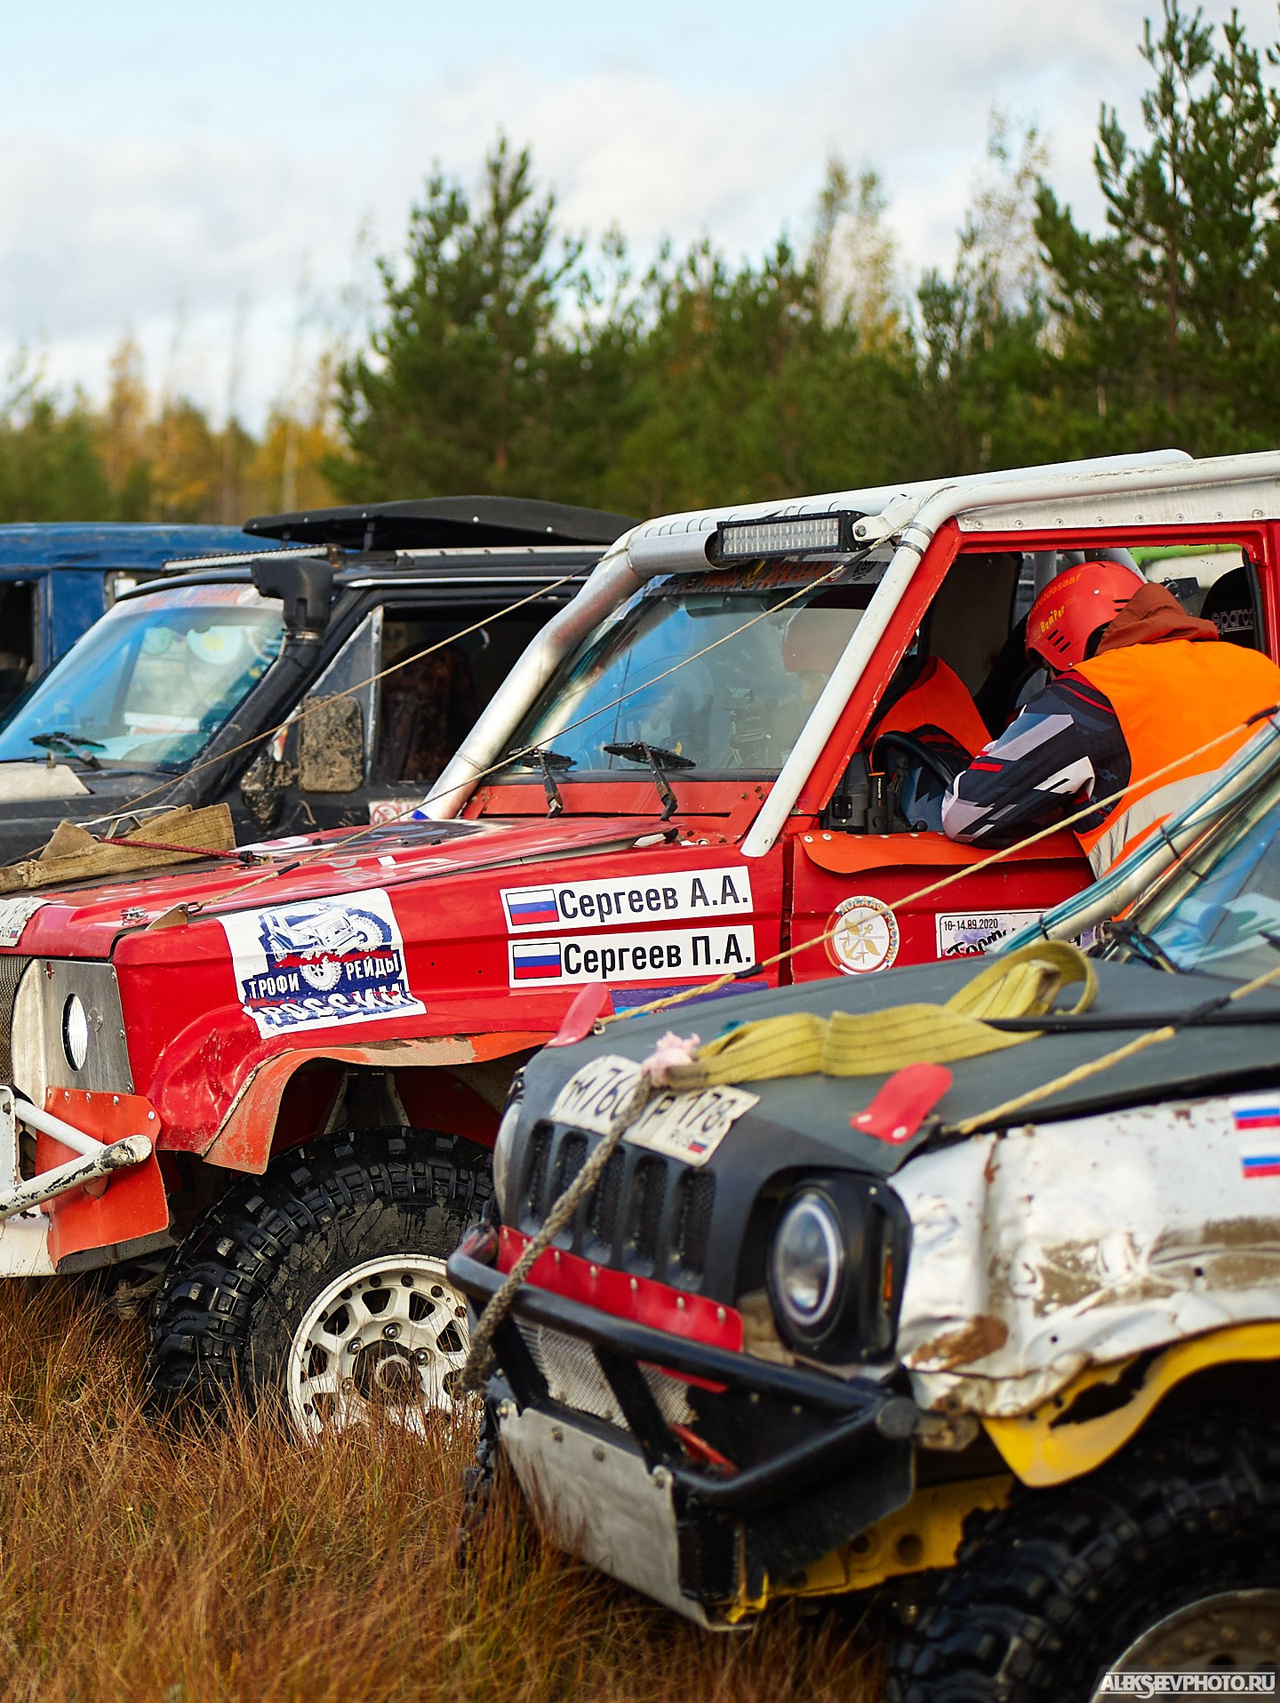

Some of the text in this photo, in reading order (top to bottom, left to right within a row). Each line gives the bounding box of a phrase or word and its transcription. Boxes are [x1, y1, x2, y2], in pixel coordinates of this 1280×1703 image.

[559, 875, 748, 922] Сергеев А.А.
[944, 918, 998, 930] 10-14.09.2020
[249, 953, 400, 999] ТРОФИ РЕЙДЫ
[564, 934, 752, 979] Сергеев П.А.
[261, 983, 417, 1025] РОССИИ
